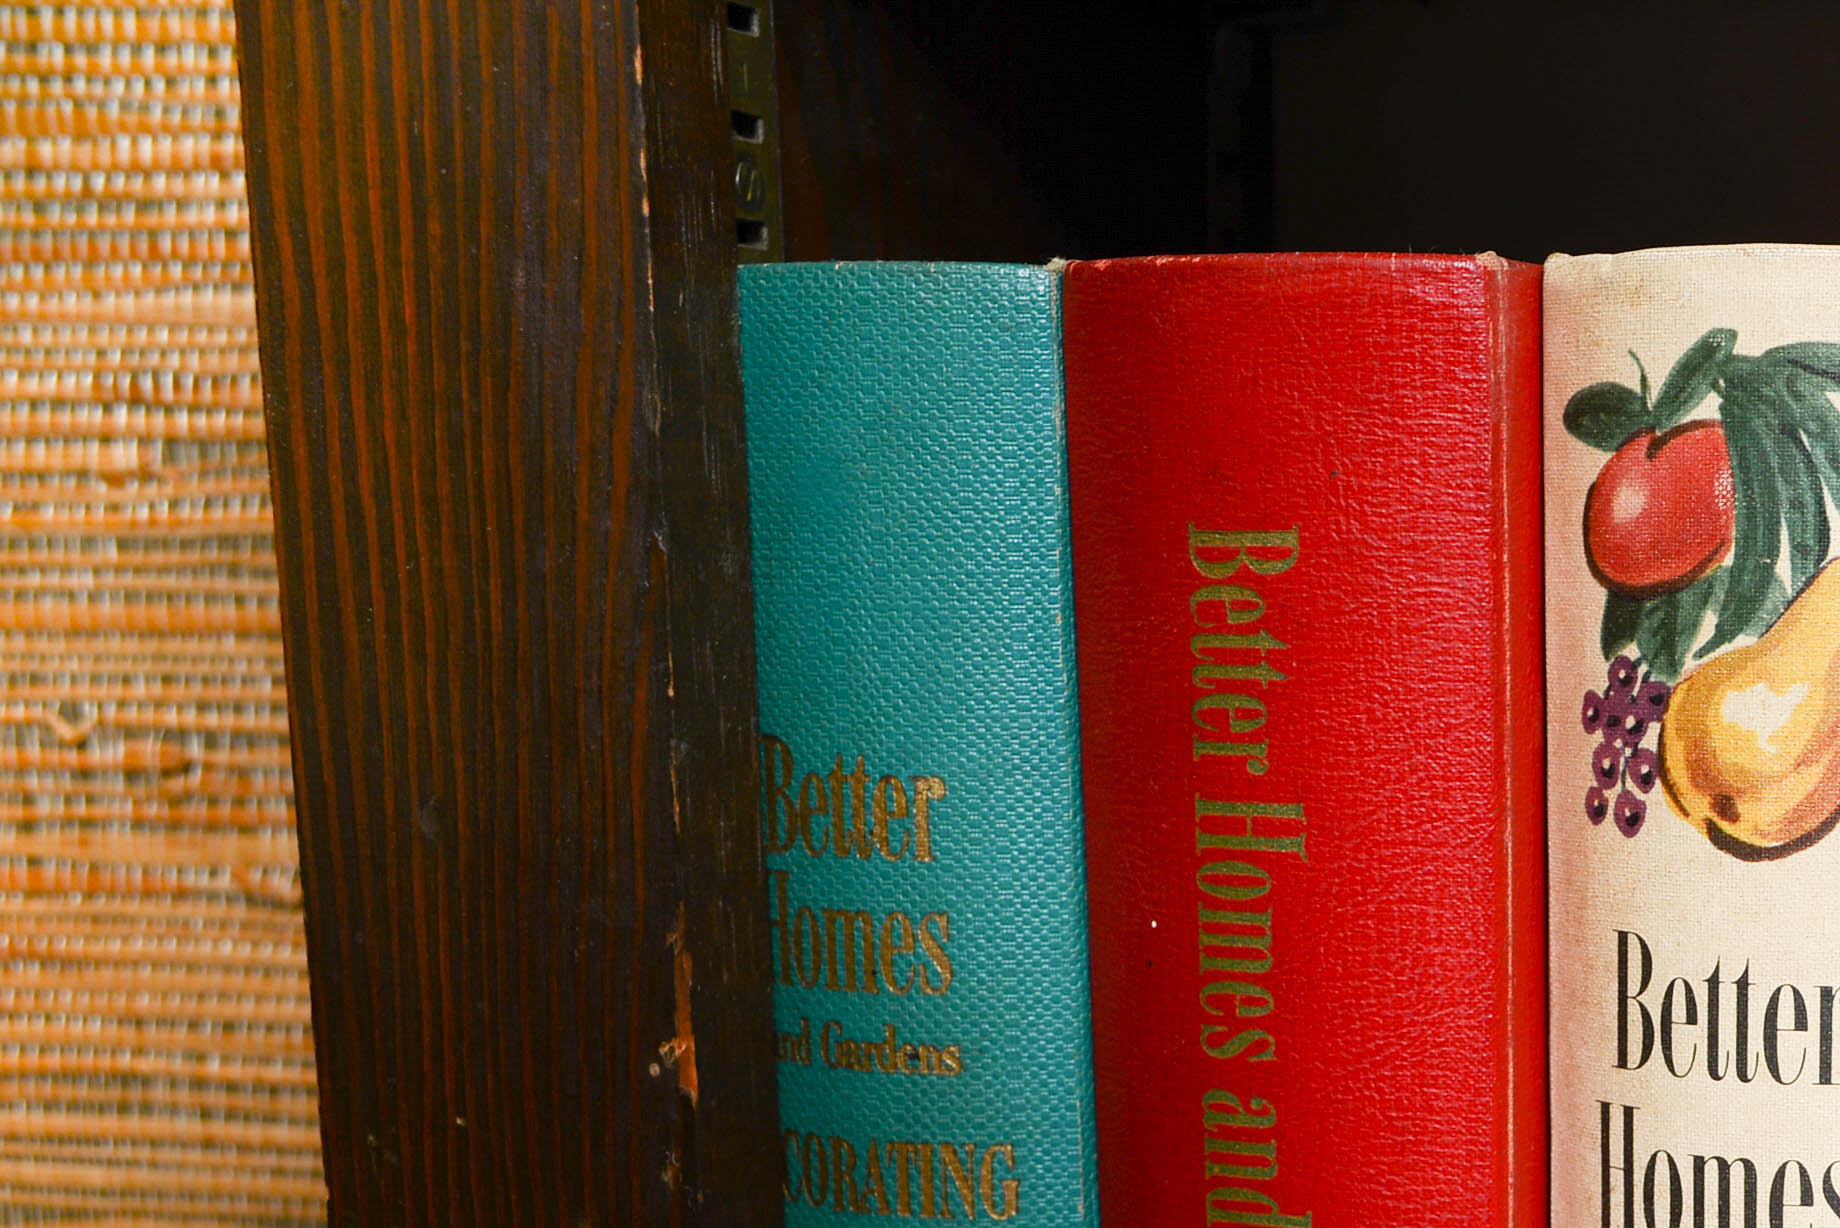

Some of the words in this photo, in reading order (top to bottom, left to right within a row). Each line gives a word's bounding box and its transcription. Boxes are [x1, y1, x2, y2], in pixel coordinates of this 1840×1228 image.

[1189, 521, 1299, 776] Better
[760, 734, 947, 863] Better
[1196, 792, 1307, 1062] Homes
[820, 1020, 963, 1077] Gardens
